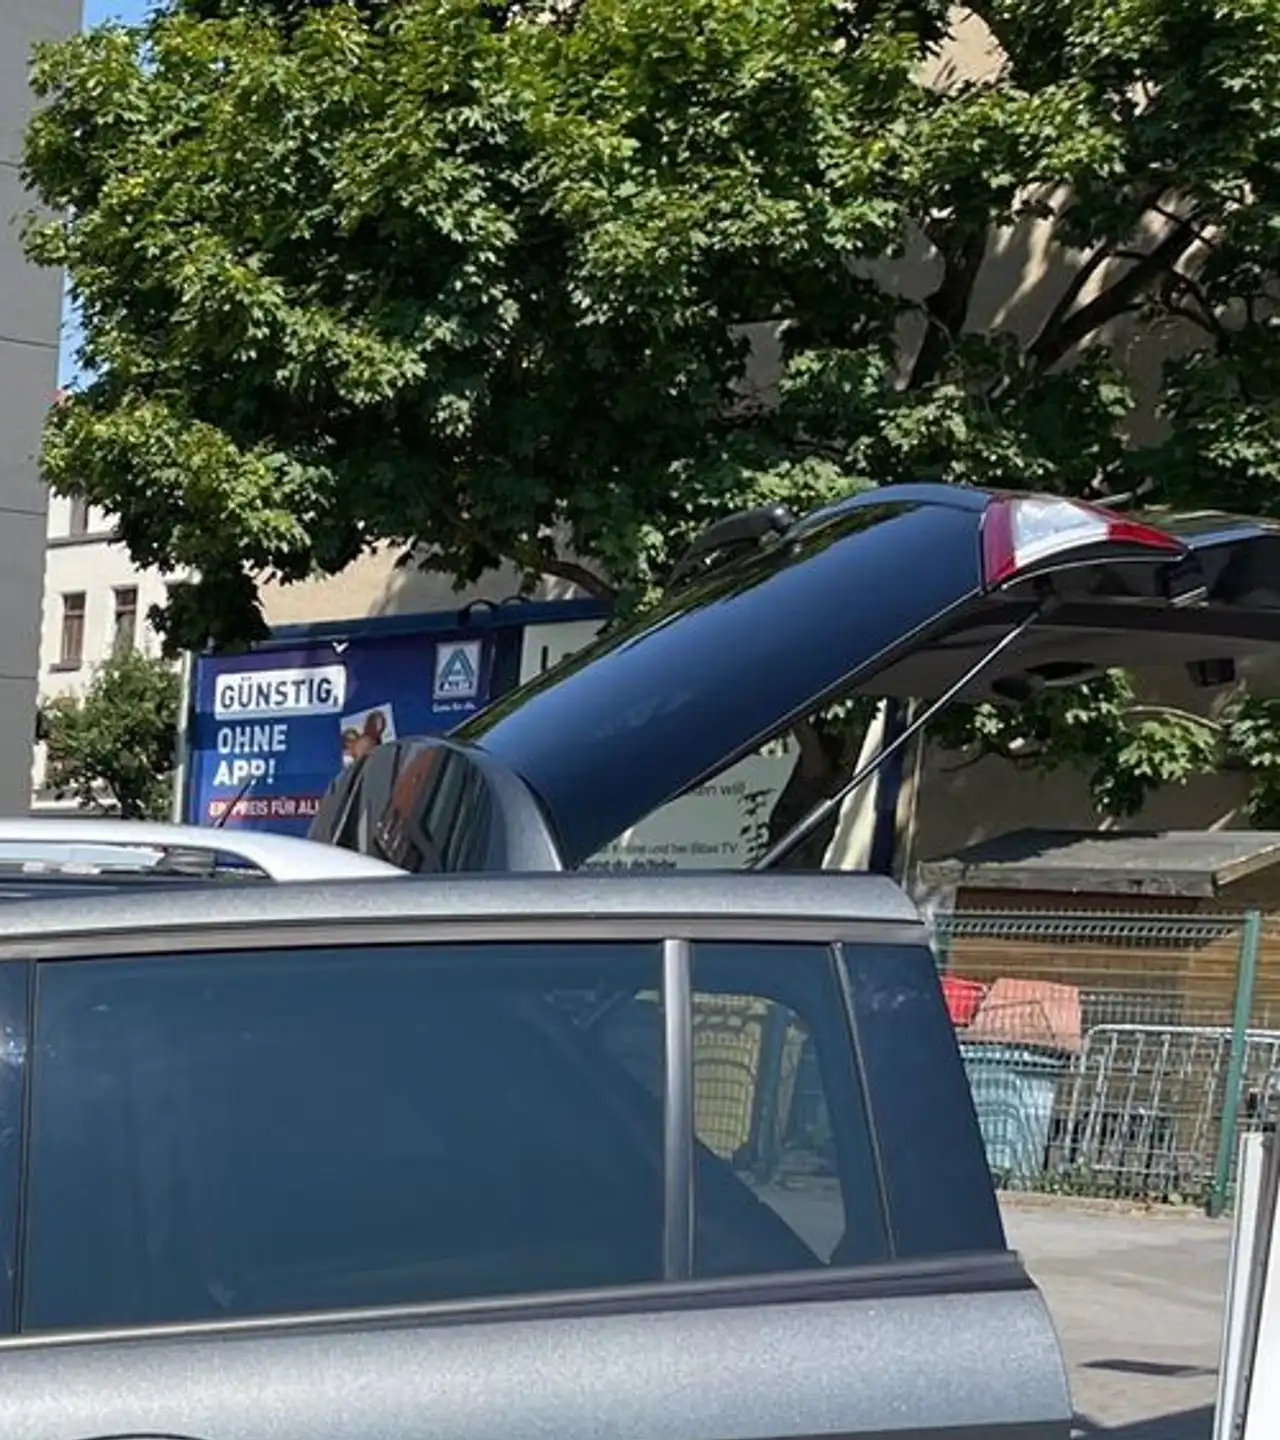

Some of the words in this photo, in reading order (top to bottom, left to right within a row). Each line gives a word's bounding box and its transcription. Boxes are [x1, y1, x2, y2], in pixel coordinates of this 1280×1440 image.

[220, 676, 339, 709] GÜNSTIG,
[217, 725, 288, 754] OHNE
[213, 758, 276, 787] APP!
